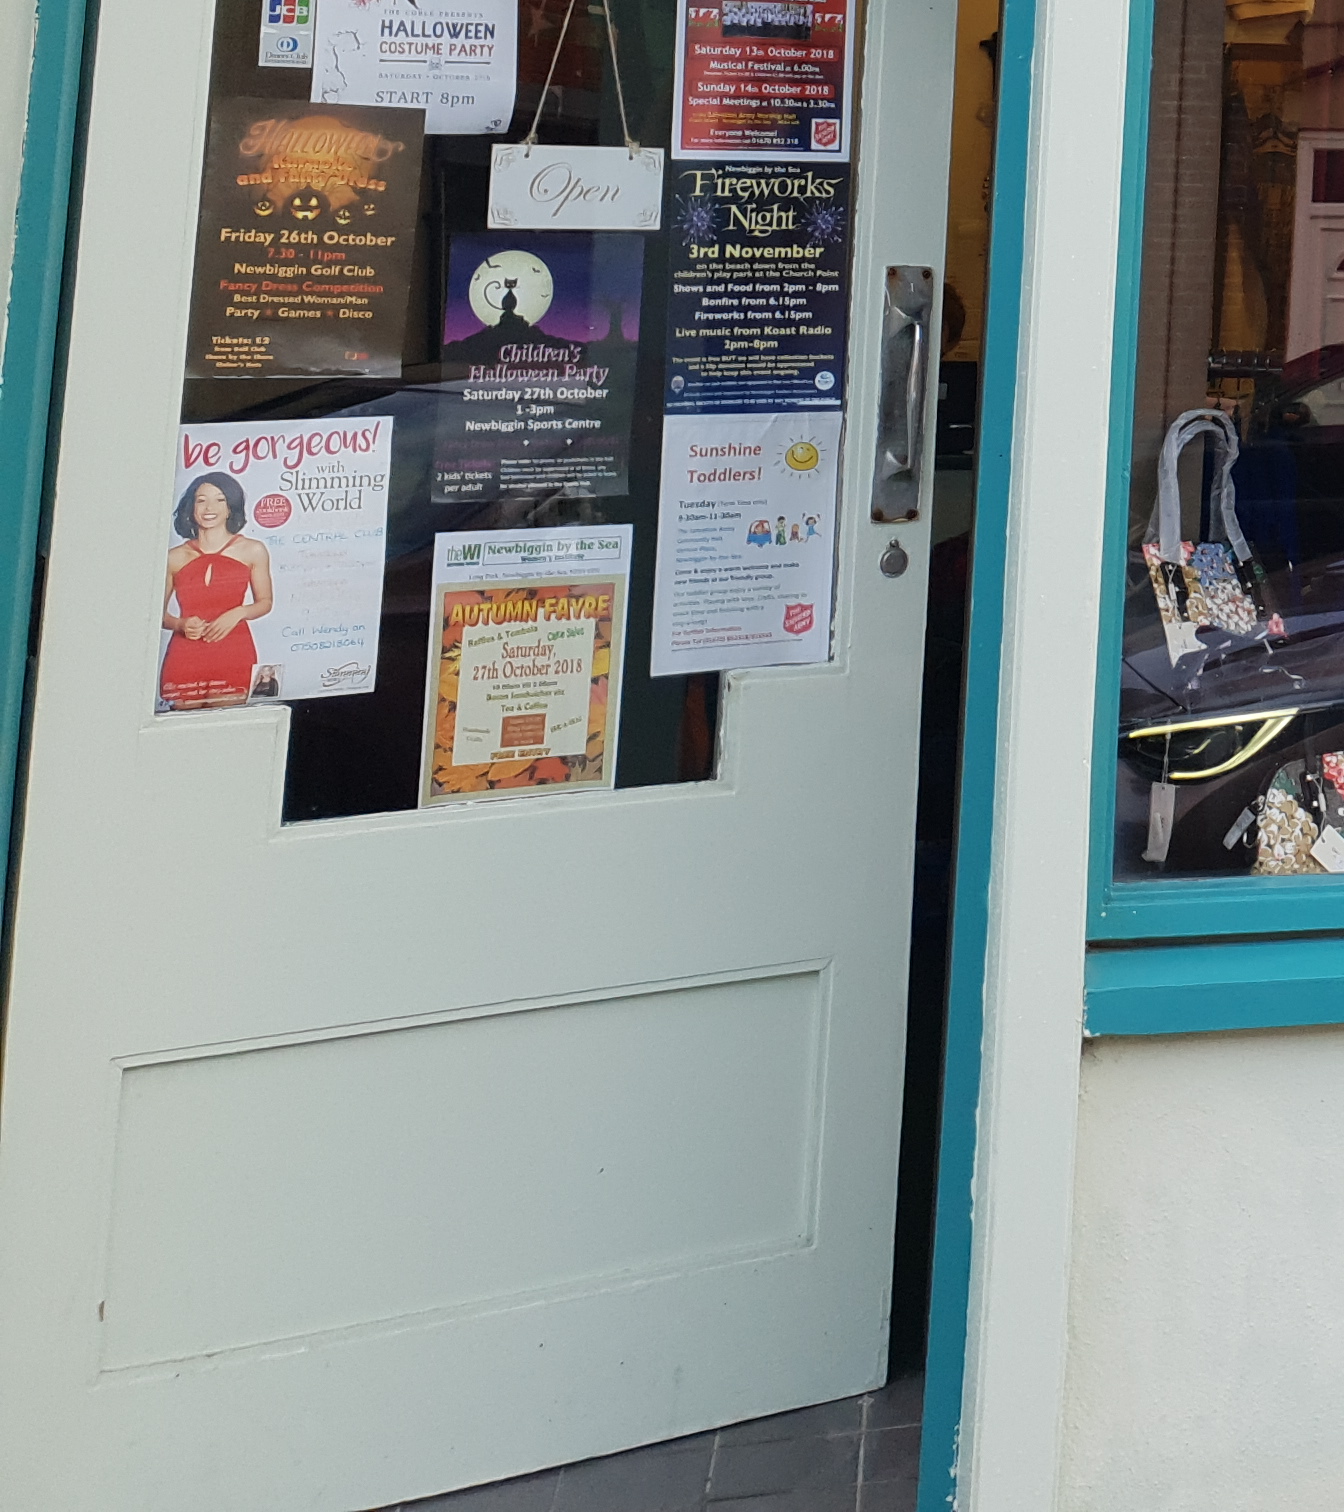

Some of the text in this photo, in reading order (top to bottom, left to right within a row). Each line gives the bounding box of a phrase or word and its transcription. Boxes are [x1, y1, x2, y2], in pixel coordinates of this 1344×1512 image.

[268, 0, 310, 21] JCB
[380, 19, 496, 41] HALLOWEEN
[379, 40, 495, 57] COSTUME PARTY
[694, 45, 835, 58] Saturday October 2018
[709, 61, 785, 71] Musical Festival
[697, 82, 829, 95] Sunday October 2018
[374, 90, 476, 108] START 8pm
[688, 96, 760, 108] Special Meetings
[236, 173, 273, 186] and
[679, 168, 845, 204] Fireworks
[528, 162, 621, 218] Open
[720, 202, 802, 237] Night
[220, 228, 396, 247] Friday 26th October
[310, 249, 346, 261] 11pm
[688, 244, 825, 259] 3rd November
[234, 263, 376, 278] Newbiggin Golf Club
[725, 262, 751, 270] beach
[714, 271, 731, 279] play
[733, 271, 753, 279] park
[783, 270, 814, 278] Church
[219, 279, 384, 294] Fancy Dress Competition
[673, 283, 704, 293] Shows
[706, 283, 726, 293] and
[727, 283, 753, 292] Food
[755, 283, 781, 292] from
[783, 283, 807, 294] 2pm
[233, 293, 258, 303] Best
[260, 294, 301, 304] Dressed
[702, 296, 807, 308] Bonfire from 6.15pm
[226, 307, 373, 319] Party Games Disco
[694, 310, 813, 321] Fireworks from 6.15pm
[675, 325, 832, 337] Live music from Koast Radio
[499, 343, 582, 363] Children's
[468, 363, 609, 387] Halloween Party
[463, 387, 609, 402] Saturday 27th October
[465, 418, 602, 433] Newbiggin Sports Centre
[183, 420, 382, 474] be gorgeous!
[688, 442, 762, 458] Sunshine
[316, 461, 345, 475] with
[687, 467, 763, 484] Toddlers!
[279, 470, 386, 492] Slimming
[444, 483, 483, 494] per adult
[260, 497, 286, 507] FREE
[296, 489, 363, 513] World
[678, 500, 717, 509] Tuesday
[487, 539, 619, 556] Newbiggin by the Sea
[449, 594, 612, 627] AUTUMN FAYRE
[281, 624, 348, 637] Call Wendy
[501, 638, 557, 659] Saturday,
[473, 657, 583, 680] 27th October 2018
